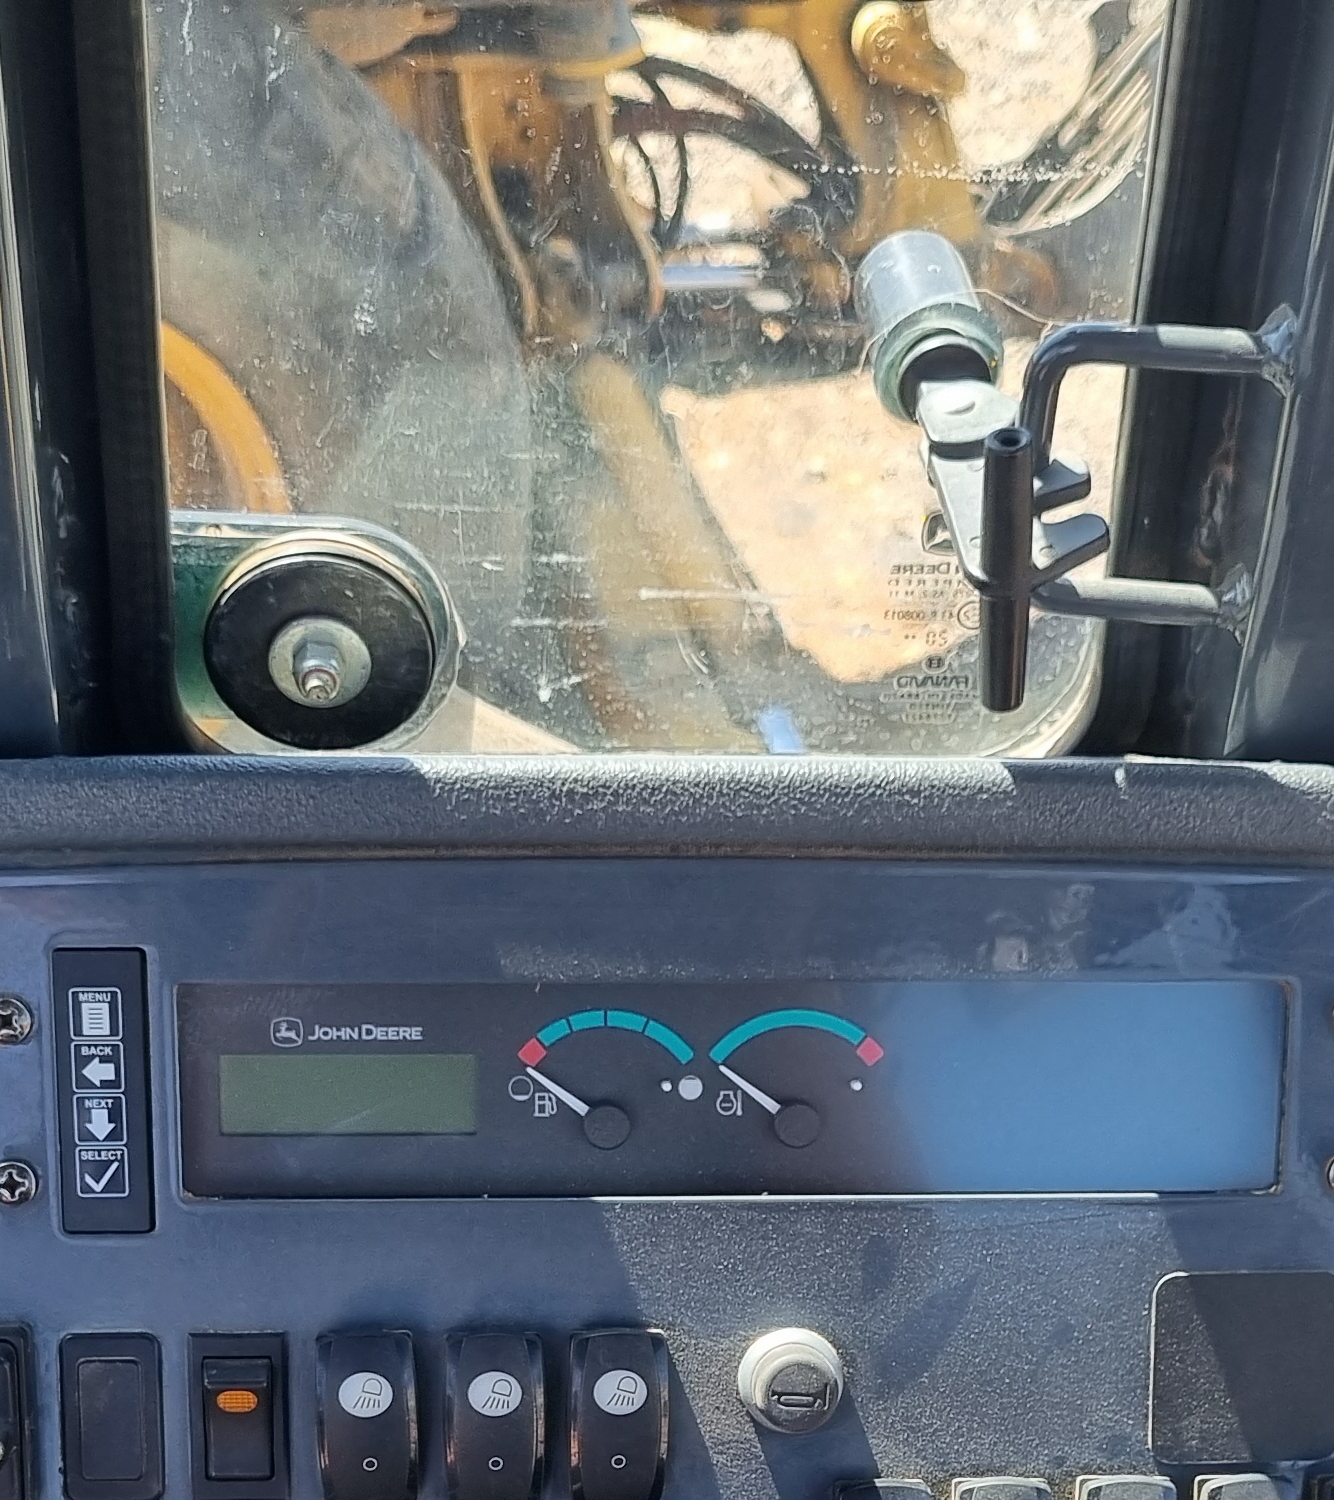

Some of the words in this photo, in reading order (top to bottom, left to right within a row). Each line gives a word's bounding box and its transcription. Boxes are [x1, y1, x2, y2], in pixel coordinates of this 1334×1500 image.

[78, 992, 111, 1002] MENU
[307, 1024, 359, 1041] JOHN
[361, 1024, 424, 1041] DEERE
[80, 1046, 113, 1056] BACK
[84, 1099, 114, 1109] NEXT
[80, 1150, 123, 1161] SELECT
